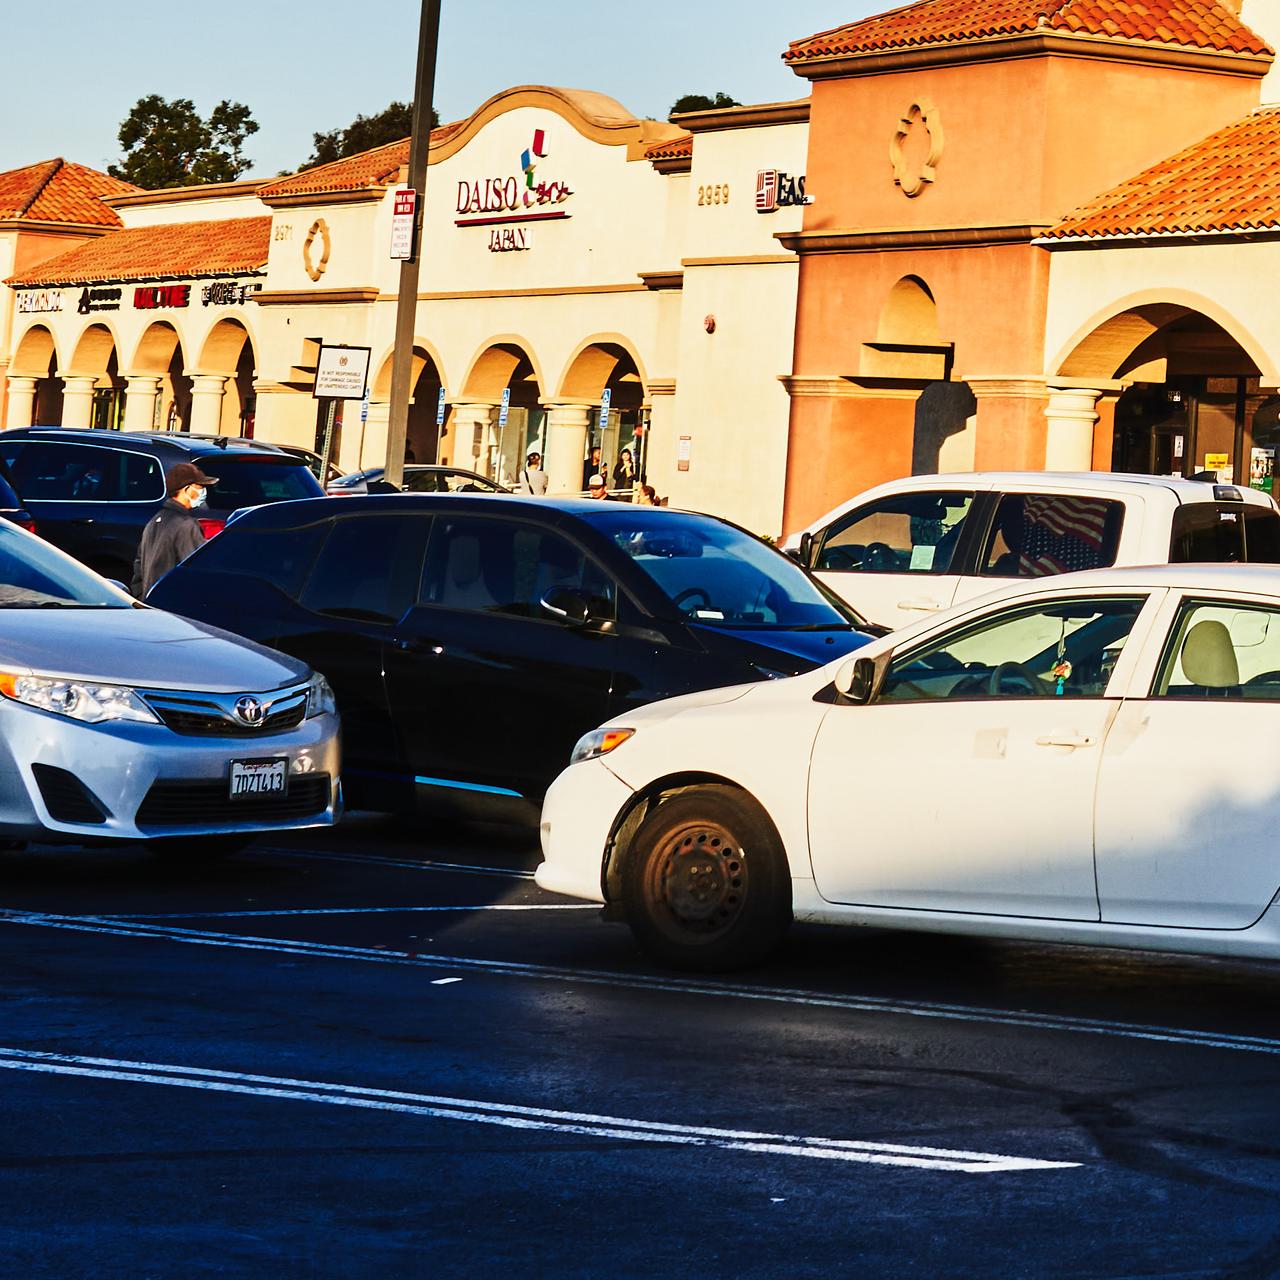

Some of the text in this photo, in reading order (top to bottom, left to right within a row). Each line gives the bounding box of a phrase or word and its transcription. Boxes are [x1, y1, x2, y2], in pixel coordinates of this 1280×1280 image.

[456, 176, 518, 213] DAISO
[698, 183, 729, 206] 2959
[488, 228, 530, 252] JAPAN
[234, 773, 283, 793] 7DZT413
